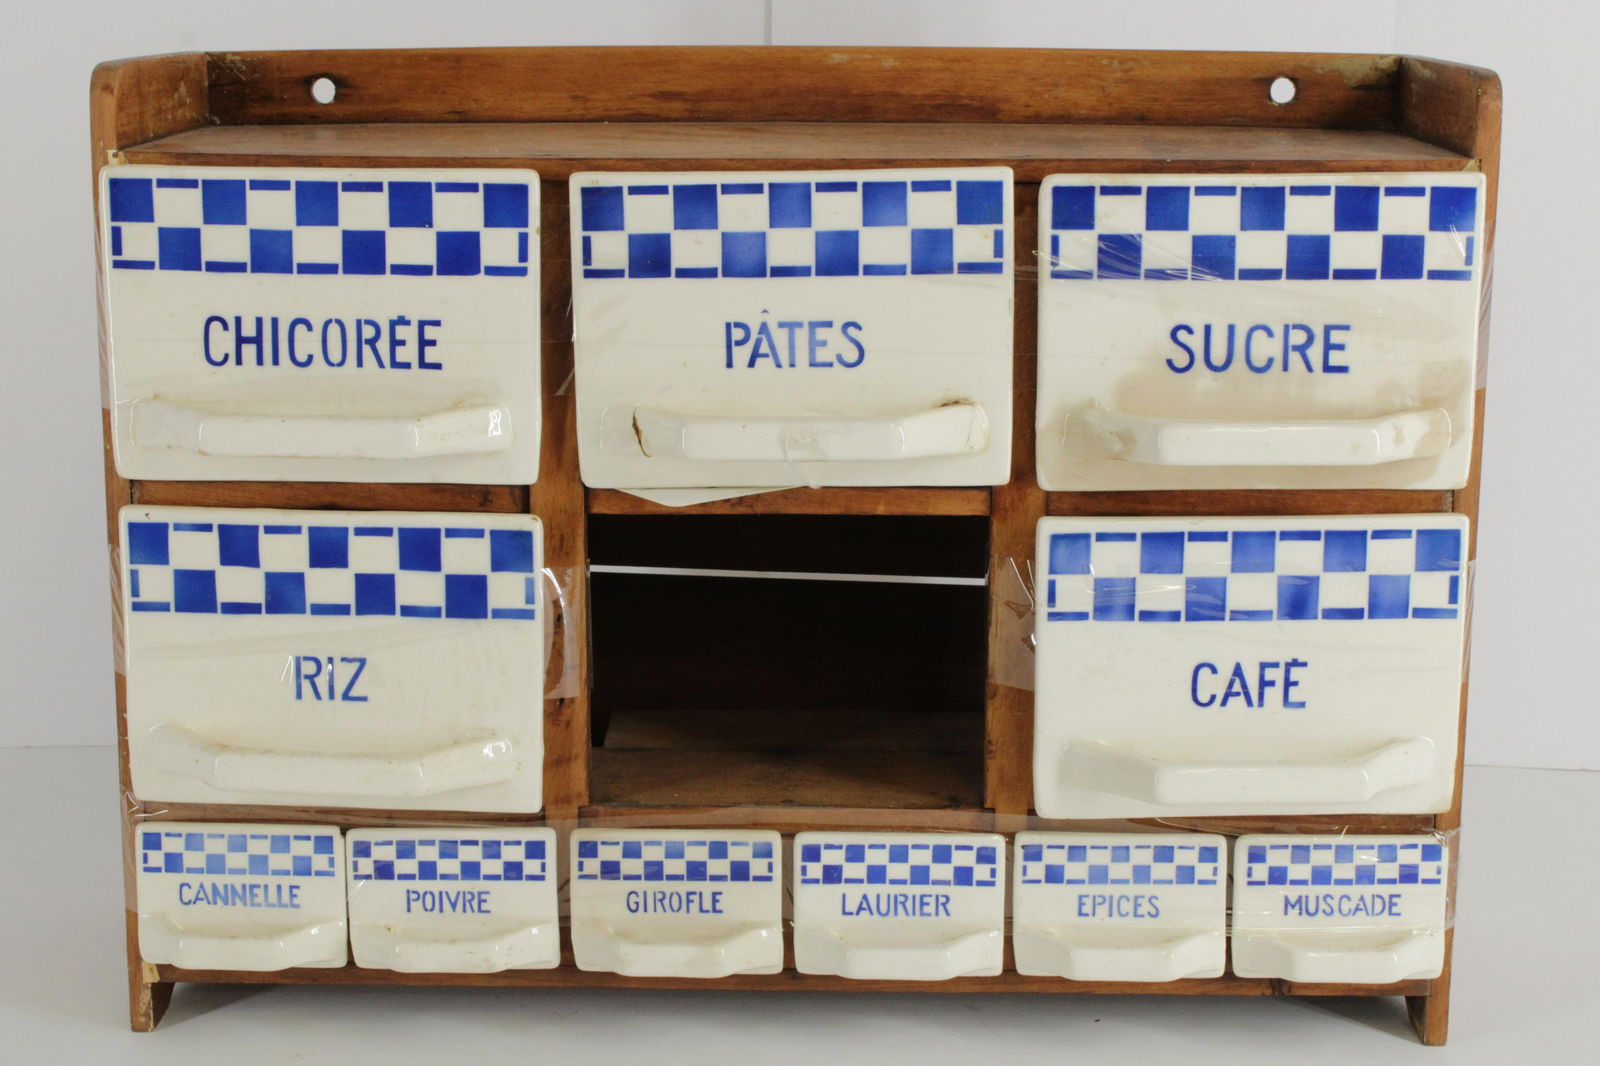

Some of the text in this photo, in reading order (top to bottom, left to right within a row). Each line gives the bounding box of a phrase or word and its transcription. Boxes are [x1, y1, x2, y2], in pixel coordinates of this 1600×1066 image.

[204, 315, 442, 370] CHICORÉE
[725, 309, 865, 369] PÂTES
[1166, 324, 1351, 374] SUCRE
[295, 656, 368, 702] RIZ
[1192, 658, 1308, 708] CAFÉ
[179, 882, 301, 909] CANNELLE
[406, 889, 491, 914] POIVRE
[626, 890, 723, 914] GIROFLE
[842, 893, 951, 917] LAURIER
[1077, 894, 1160, 918] EPICES
[1284, 894, 1402, 918] MUSCADE
